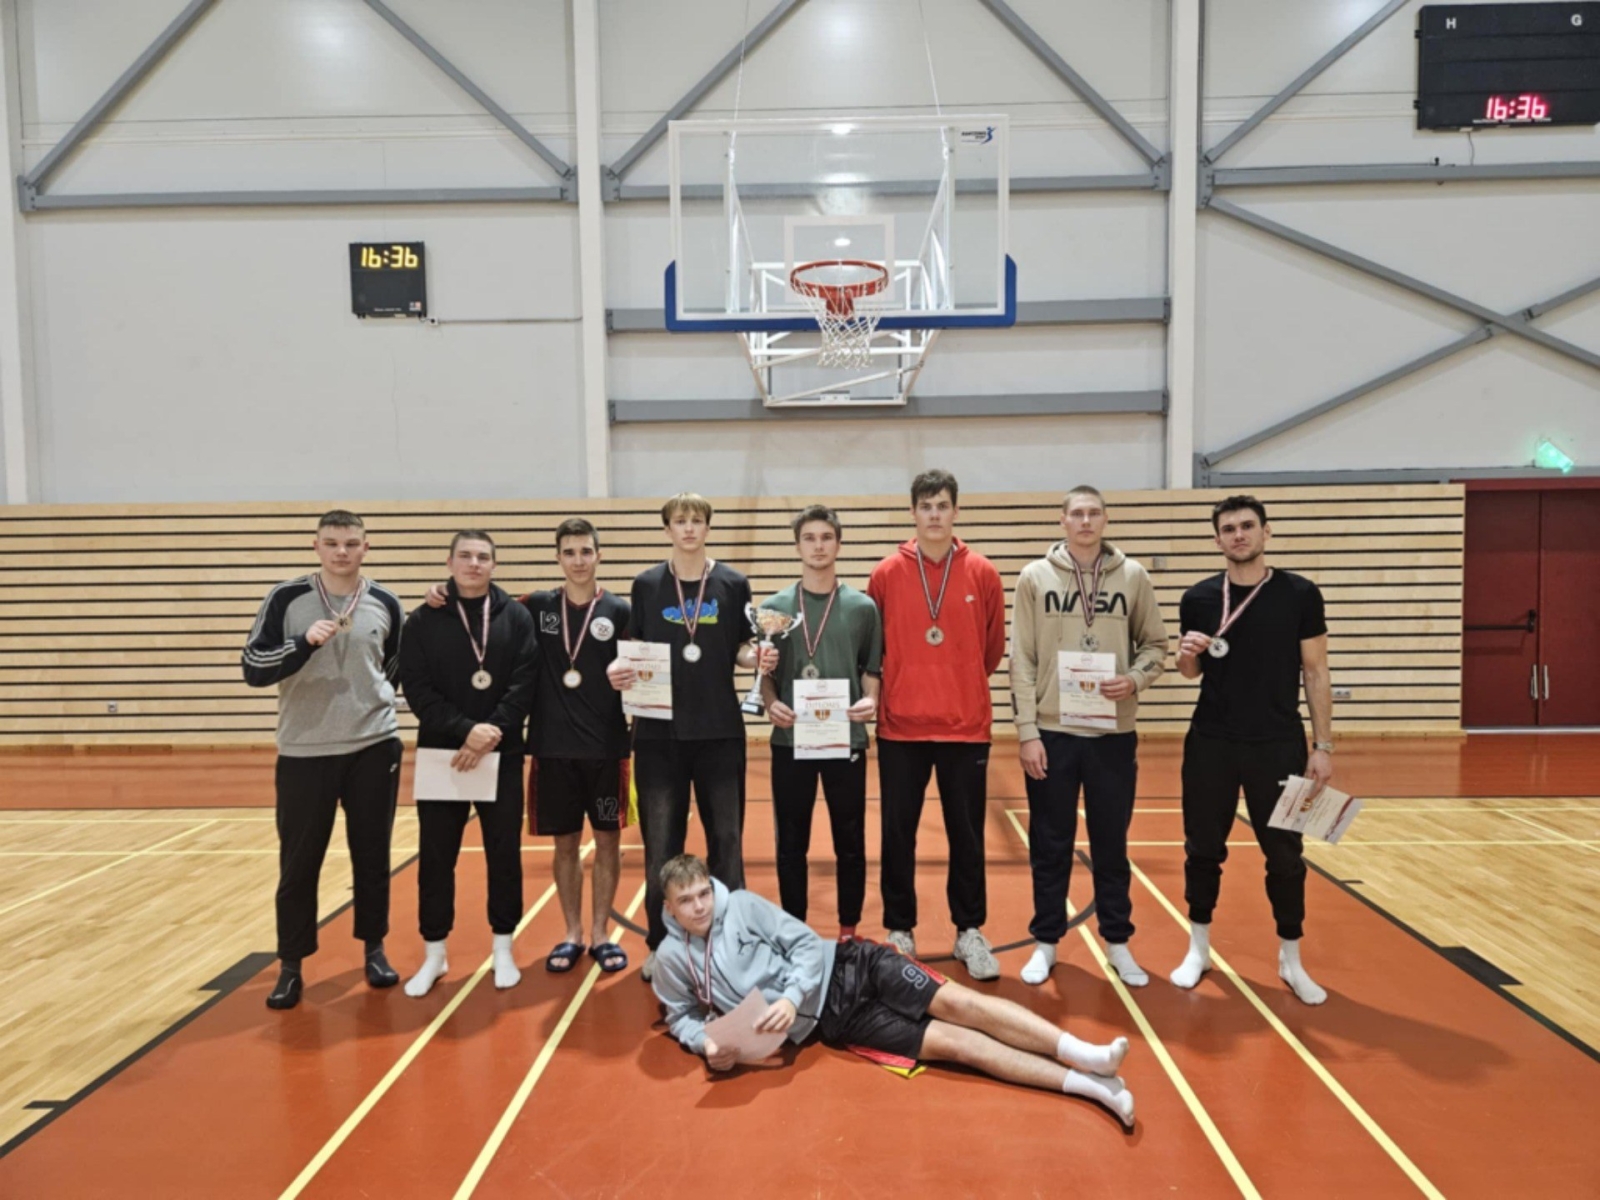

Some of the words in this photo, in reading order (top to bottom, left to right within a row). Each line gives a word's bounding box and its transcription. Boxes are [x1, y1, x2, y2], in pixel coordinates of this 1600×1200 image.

[1445, 17, 1457, 29] H
[1571, 14, 1582, 27] G
[1486, 95, 1546, 120] 16:36
[361, 245, 419, 268] 16:36
[1045, 590, 1127, 616] NASA
[540, 610, 560, 635] 12
[596, 797, 619, 821] 12
[902, 964, 929, 990] 9
